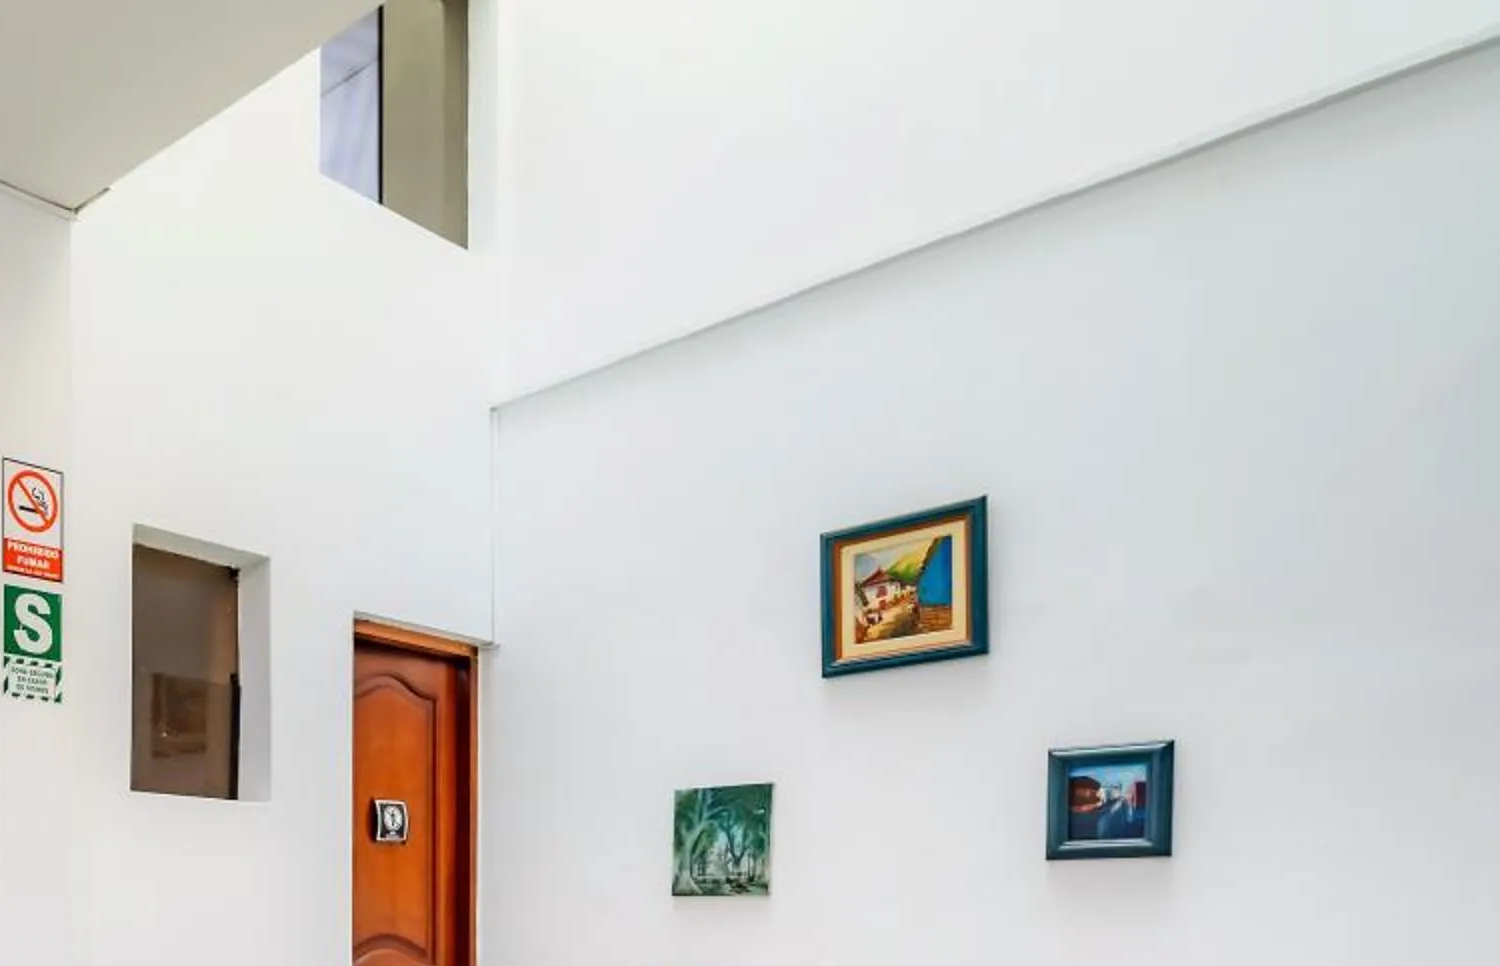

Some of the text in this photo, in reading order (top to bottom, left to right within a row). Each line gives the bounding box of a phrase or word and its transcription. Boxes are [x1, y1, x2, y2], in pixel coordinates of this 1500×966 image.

[7, 541, 59, 559] PROHIBIDO
[16, 555, 50, 570] FUMAR
[14, 594, 52, 654] S
